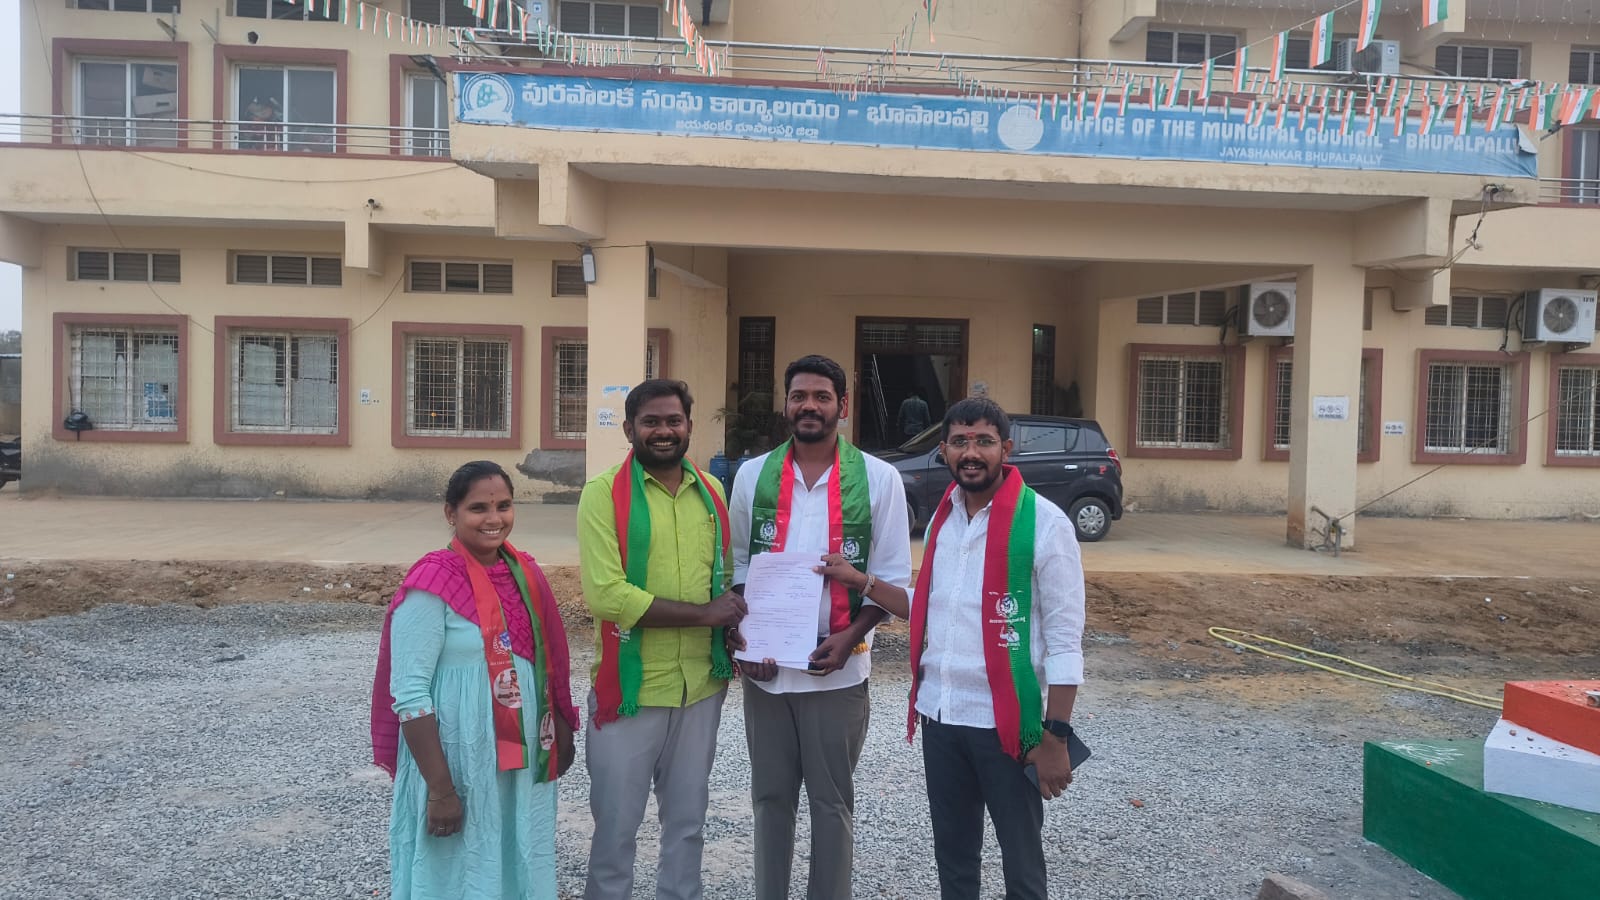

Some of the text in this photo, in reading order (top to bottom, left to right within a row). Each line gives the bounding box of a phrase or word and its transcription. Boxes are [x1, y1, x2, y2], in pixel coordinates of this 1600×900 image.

[522, 82, 634, 106] పురపాలక
[641, 89, 703, 112] సంఘ
[710, 95, 840, 122] కార్యాలయం
[866, 103, 989, 133] భూపాలపల్లి
[1061, 115, 1125, 135] OFFICE
[1132, 118, 1155, 136] OF
[1161, 119, 1196, 137] THE
[1202, 121, 1299, 143] MUNCIPAL
[1304, 127, 1383, 147] COUNCIL
[1219, 146, 1383, 165] JAYASHANKAR BHUPALPALLY
